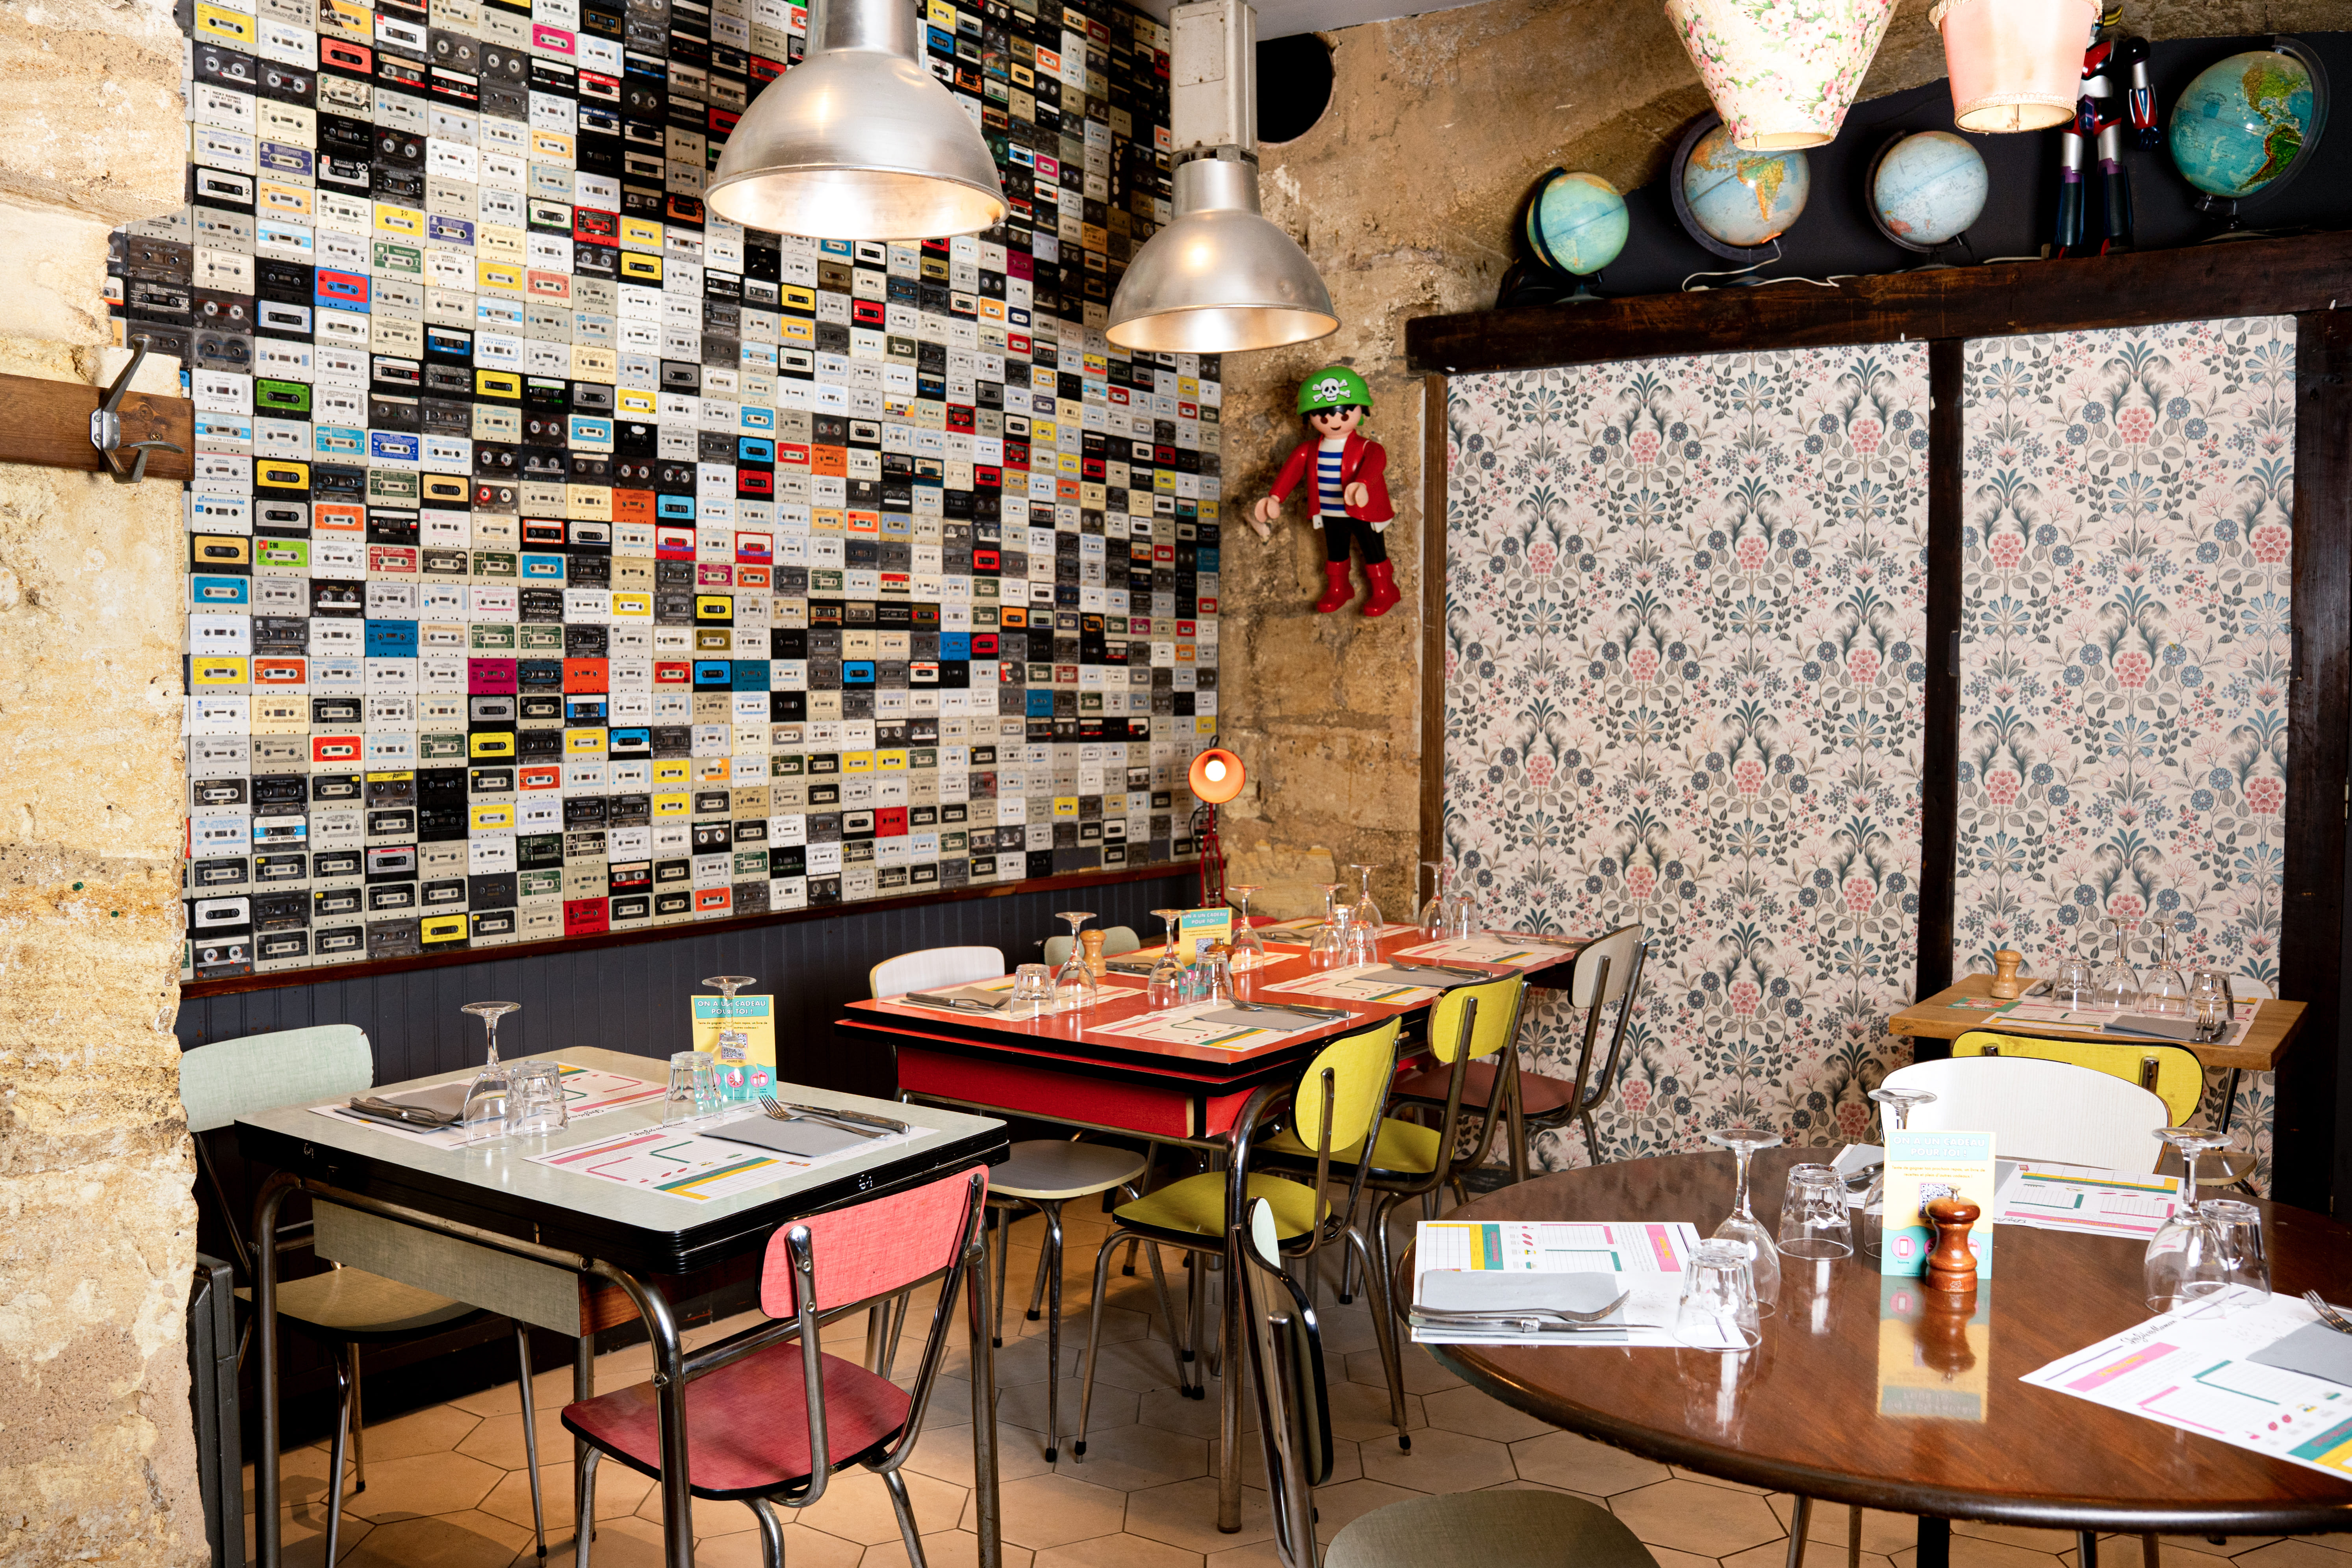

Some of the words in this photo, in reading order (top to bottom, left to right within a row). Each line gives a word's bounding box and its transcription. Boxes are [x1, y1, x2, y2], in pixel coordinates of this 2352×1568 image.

[356, 162, 368, 172] 90
[1893, 1136, 1911, 1145] ON
[1924, 1137, 1941, 1145] UN
[1944, 1137, 1986, 1147] CADEAU
[1911, 1148, 1940, 1156] POUR
[1943, 1149, 1961, 1157] TOI
